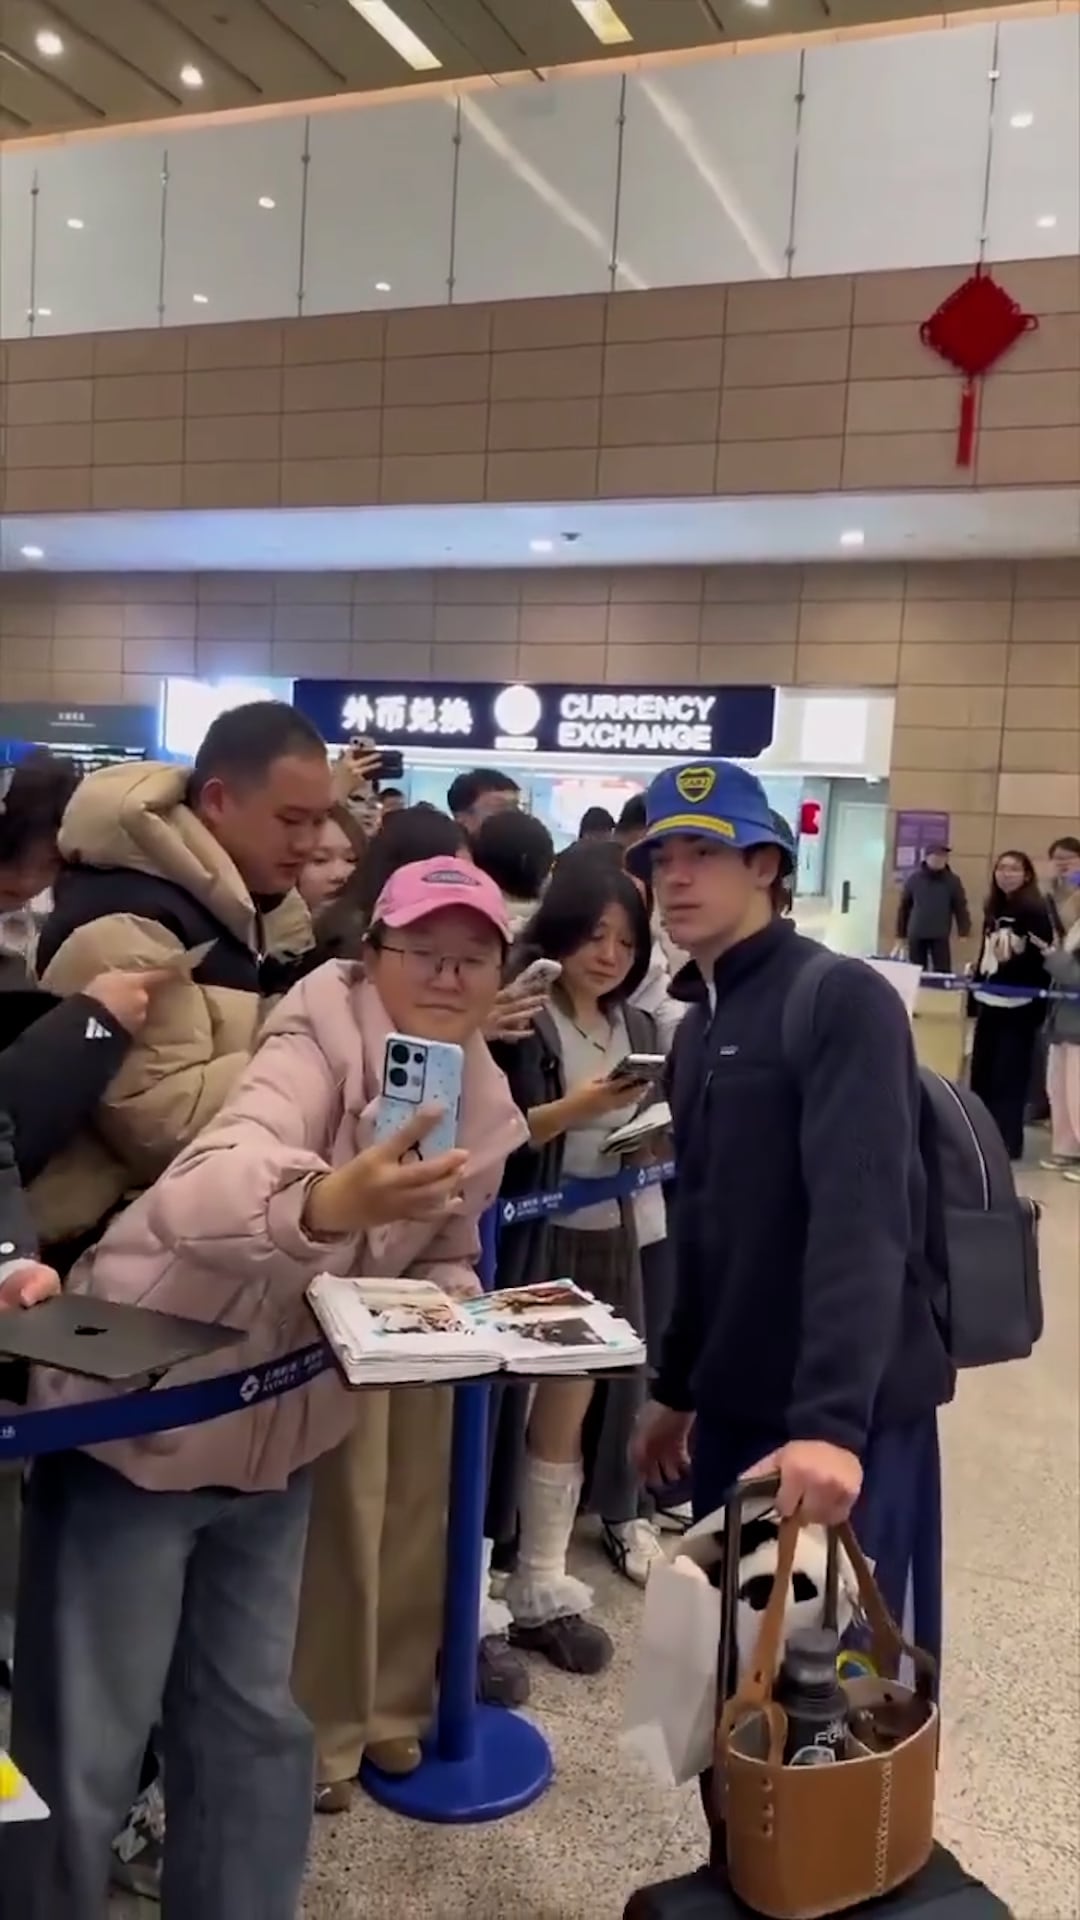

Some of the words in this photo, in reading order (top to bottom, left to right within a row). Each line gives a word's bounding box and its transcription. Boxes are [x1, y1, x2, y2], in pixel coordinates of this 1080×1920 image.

[341, 695, 473, 735] 外币兑换
[561, 693, 717, 721] CURRENCY
[558, 721, 713, 751] EXCHANGE
